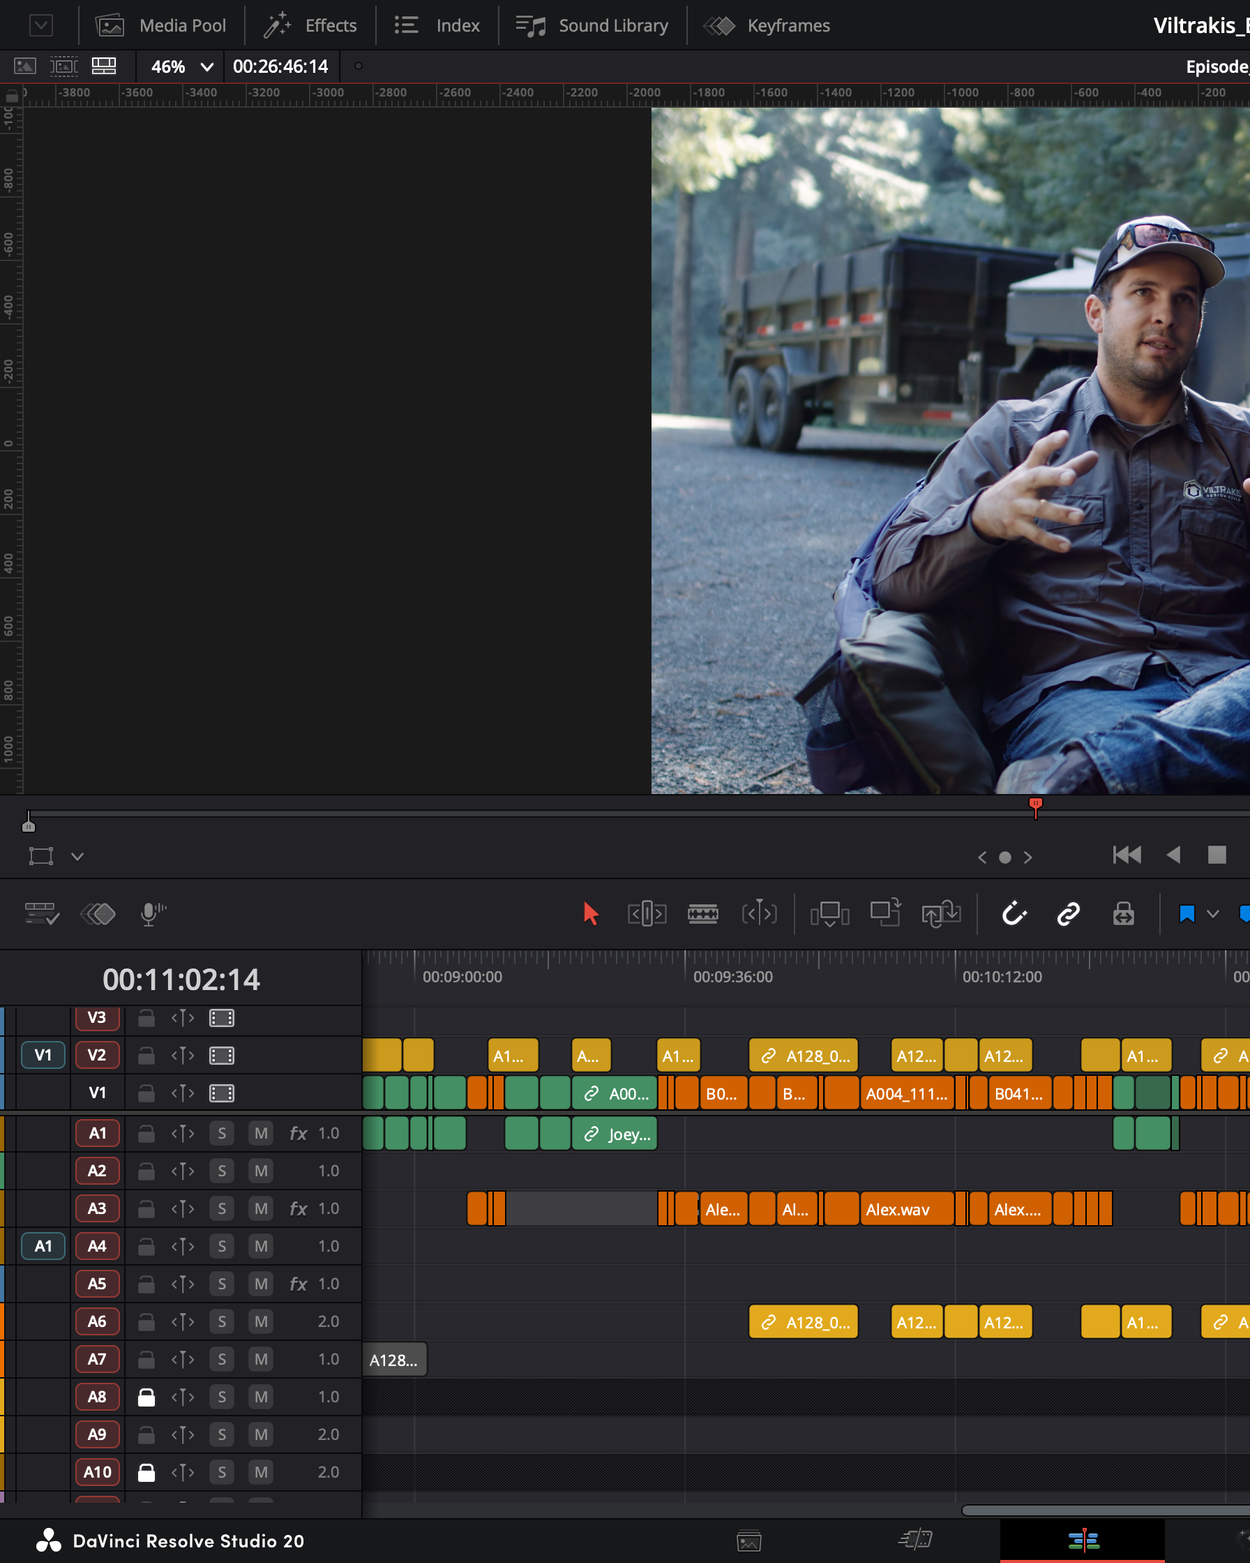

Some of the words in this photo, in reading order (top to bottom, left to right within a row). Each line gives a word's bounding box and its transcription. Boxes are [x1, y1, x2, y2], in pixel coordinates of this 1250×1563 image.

[140, 18, 187, 33] Media
[192, 18, 226, 33] Pool
[306, 17, 357, 33] Effects
[437, 18, 480, 33] Index
[559, 18, 609, 33] Sound
[614, 17, 669, 37] Library
[748, 17, 831, 37] Keyframes
[151, 59, 186, 74] 46%
[233, 58, 329, 74] 00:26:46:14
[58, 87, 91, 98] -3800
[121, 87, 154, 98] -3600
[185, 87, 218, 98] -3400
[248, 87, 280, 98] -3200
[312, 87, 345, 98] -3000
[375, 87, 407, 98] -2800
[439, 87, 472, 98] -2600
[501, 87, 534, 98] -2400
[566, 87, 599, 98] -2200
[628, 87, 661, 98] -2000
[693, 87, 726, 98] -1800
[755, 87, 788, 98] -1600
[820, 87, 852, 98] -1400
[882, 87, 915, 98] -1200
[947, 87, 979, 98] -1000
[1009, 87, 1035, 98] -800
[1073, 87, 1099, 98] -600
[1136, 87, 1162, 98] -400
[1200, 87, 1226, 98] -200
[3, 168, 14, 194] -800
[3, 232, 14, 258] -600
[3, 295, 14, 320] -400
[3, 359, 14, 385] -200
[1201, 485, 1243, 498] VILTRAKIS
[3, 488, 14, 510] 200
[3, 553, 14, 574] 400
[3, 615, 14, 637] 600
[3, 680, 14, 701] 800
[3, 735, 14, 764] 1000
[102, 967, 261, 991] 00:11:02:14
[422, 970, 503, 983] 00:09:00:00
[693, 970, 774, 983] 00:09:36:00
[962, 970, 1043, 983] 00:10:12:00
[87, 1010, 107, 1024] V3
[34, 1048, 52, 1062] V1
[87, 1048, 107, 1062] V2
[88, 1086, 106, 1099] V1
[88, 1126, 106, 1140] A1
[318, 1126, 340, 1139] 1.0
[87, 1164, 107, 1178] A2
[87, 1201, 107, 1215] A3
[318, 1202, 340, 1215] 1.0
[865, 1202, 930, 1216] Alex.wav
[34, 1239, 52, 1253] A1
[87, 1239, 108, 1253] A4
[87, 1277, 107, 1291] A5
[318, 1277, 340, 1290] 1.0
[87, 1314, 107, 1328] A6
[318, 1315, 340, 1328] 2.0
[87, 1352, 107, 1366] A7
[318, 1353, 340, 1366] 1.0
[87, 1390, 107, 1404] A8
[87, 1427, 107, 1441] A9
[318, 1428, 340, 1441] 2.0
[82, 1465, 112, 1479] A10
[318, 1466, 340, 1479] 2.0
[73, 1533, 140, 1549] DaVinci
[146, 1533, 215, 1549] Resolve
[220, 1533, 277, 1549] Studio
[283, 1534, 305, 1549] 20
